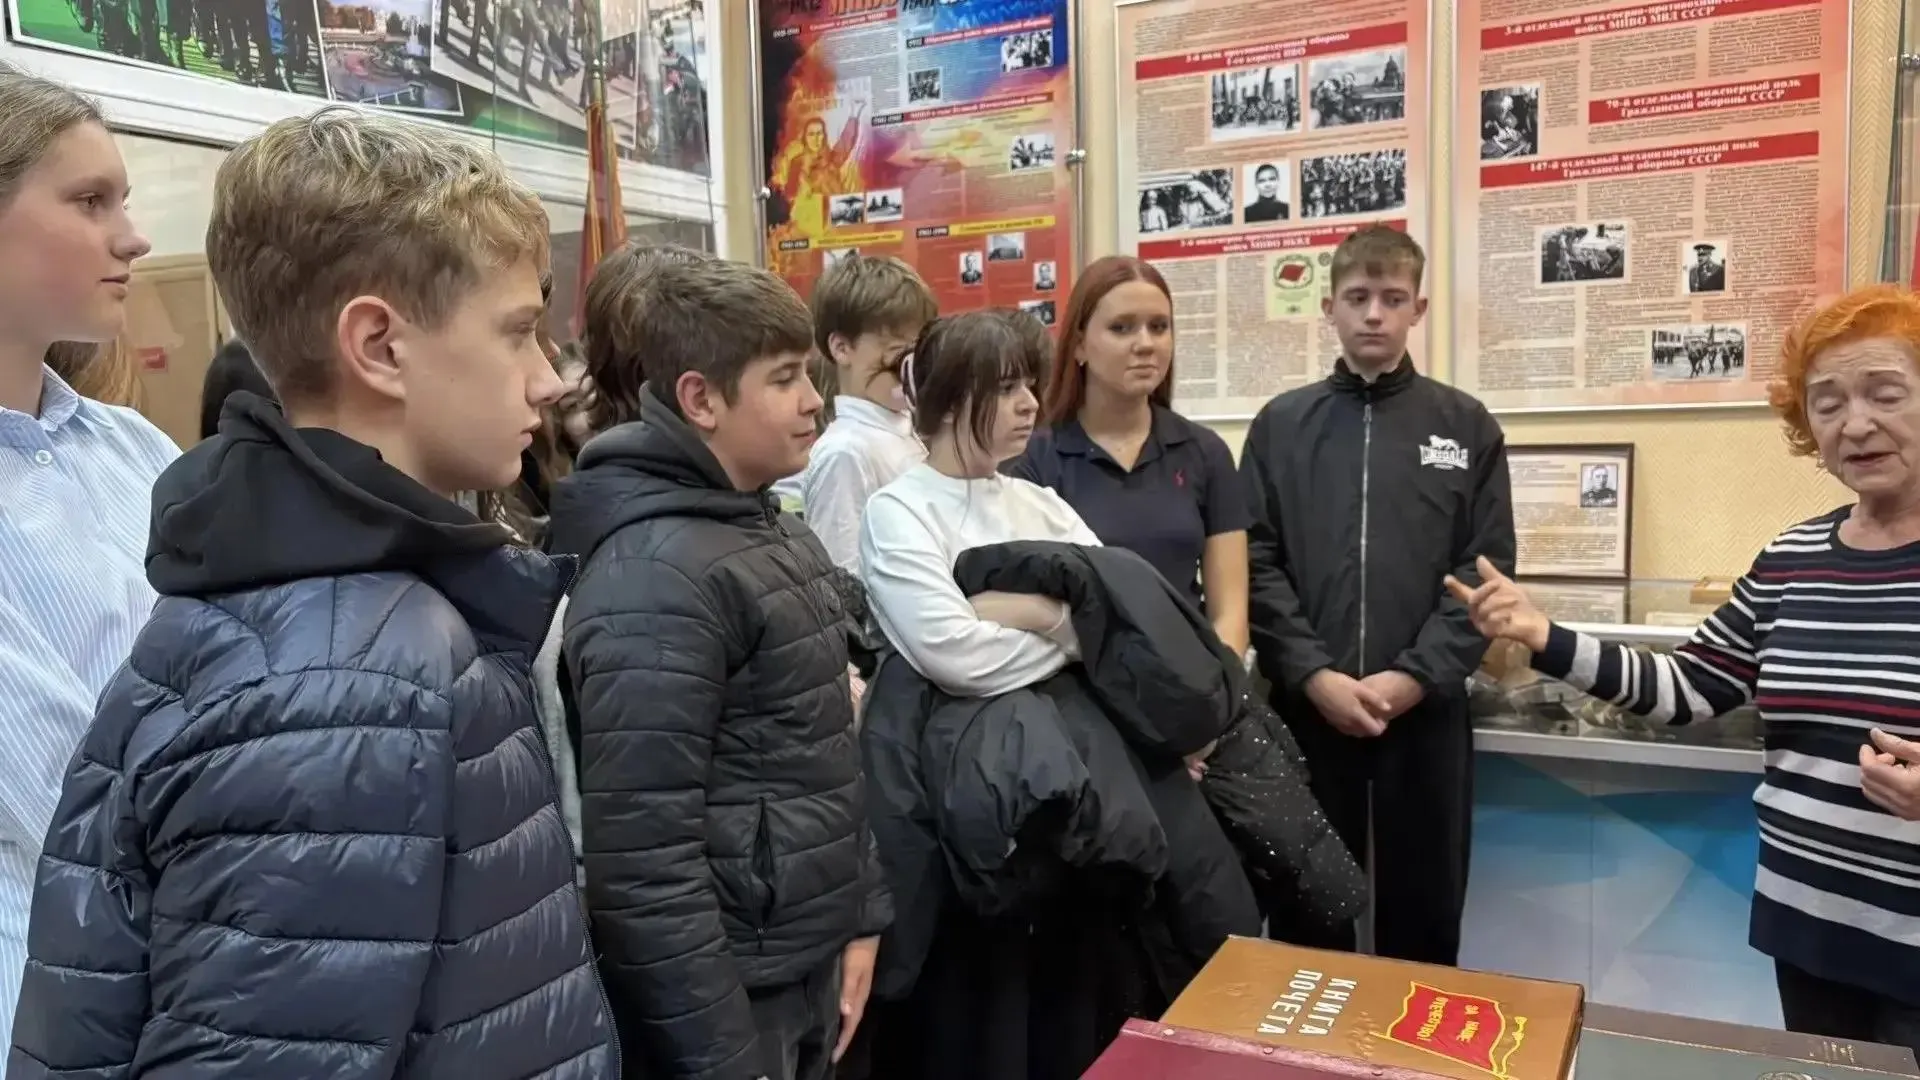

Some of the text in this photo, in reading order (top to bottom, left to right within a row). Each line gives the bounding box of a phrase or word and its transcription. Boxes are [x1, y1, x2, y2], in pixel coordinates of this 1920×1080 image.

[1681, 6, 1716, 20] СССР
[1621, 89, 1785, 118] Гражданской обороны СССР
[1633, 90, 1694, 107] отдельный
[1696, 80, 1770, 98] инженерный
[1561, 154, 1619, 168] отдельный
[1621, 143, 1729, 163] механизированный
[1563, 152, 1722, 179] Гражданской обороны СССР
[1256, 969, 1323, 1034] ПОЧЕТА
[1298, 978, 1357, 1035] КНИГА
